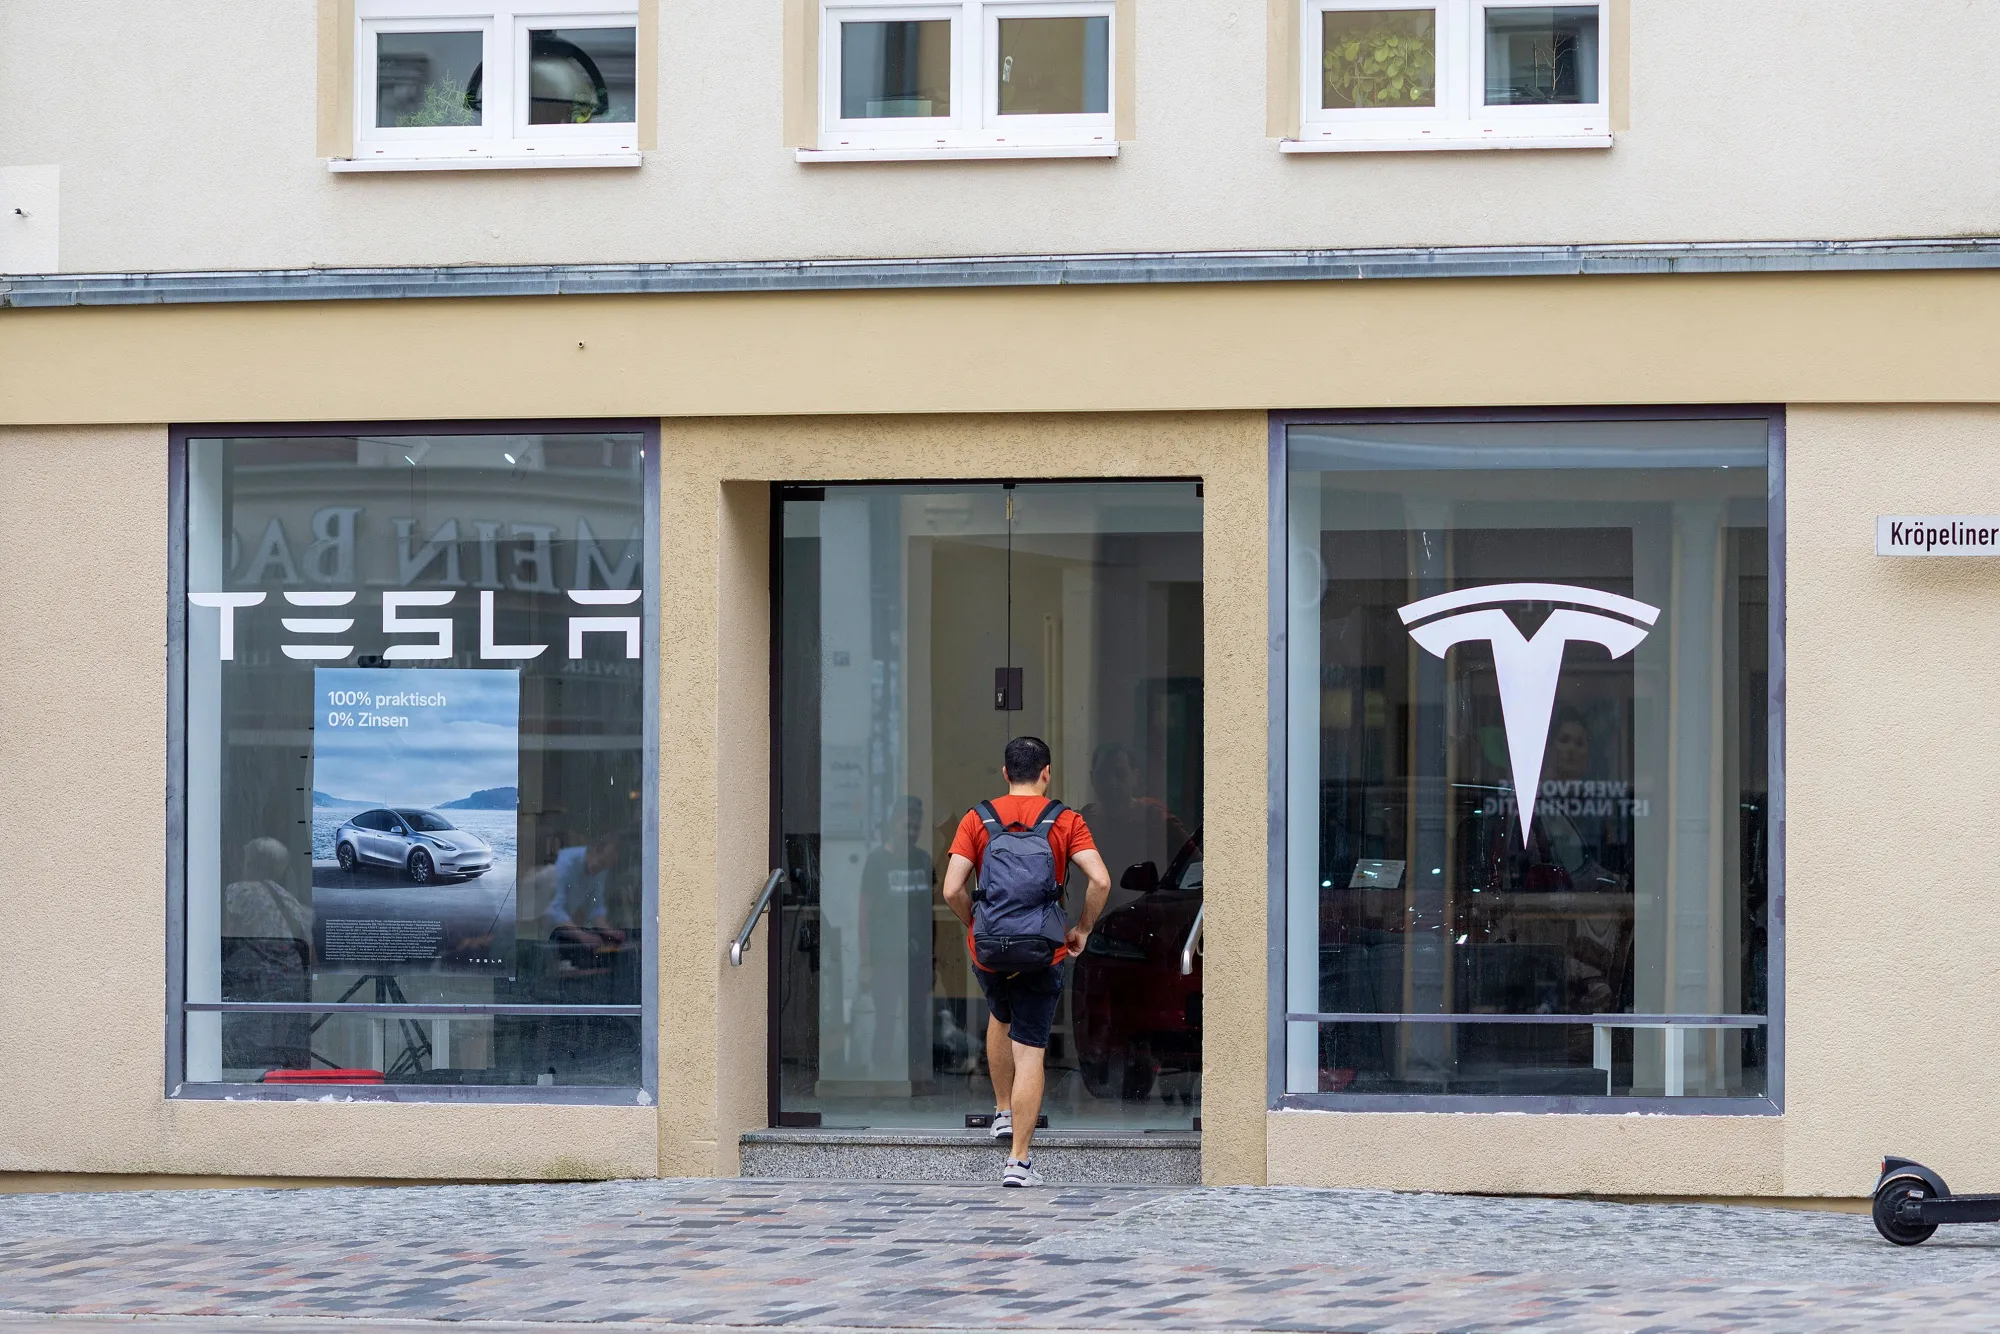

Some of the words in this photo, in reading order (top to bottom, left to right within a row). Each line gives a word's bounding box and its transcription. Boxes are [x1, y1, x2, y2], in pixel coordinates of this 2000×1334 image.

[1891, 522, 2000, 552] Kröpeliner
[188, 590, 642, 660] TESLA
[328, 691, 371, 706] 100%
[375, 692, 446, 709] praktisch
[328, 712, 354, 727] 0%
[358, 712, 408, 727] Zinsen
